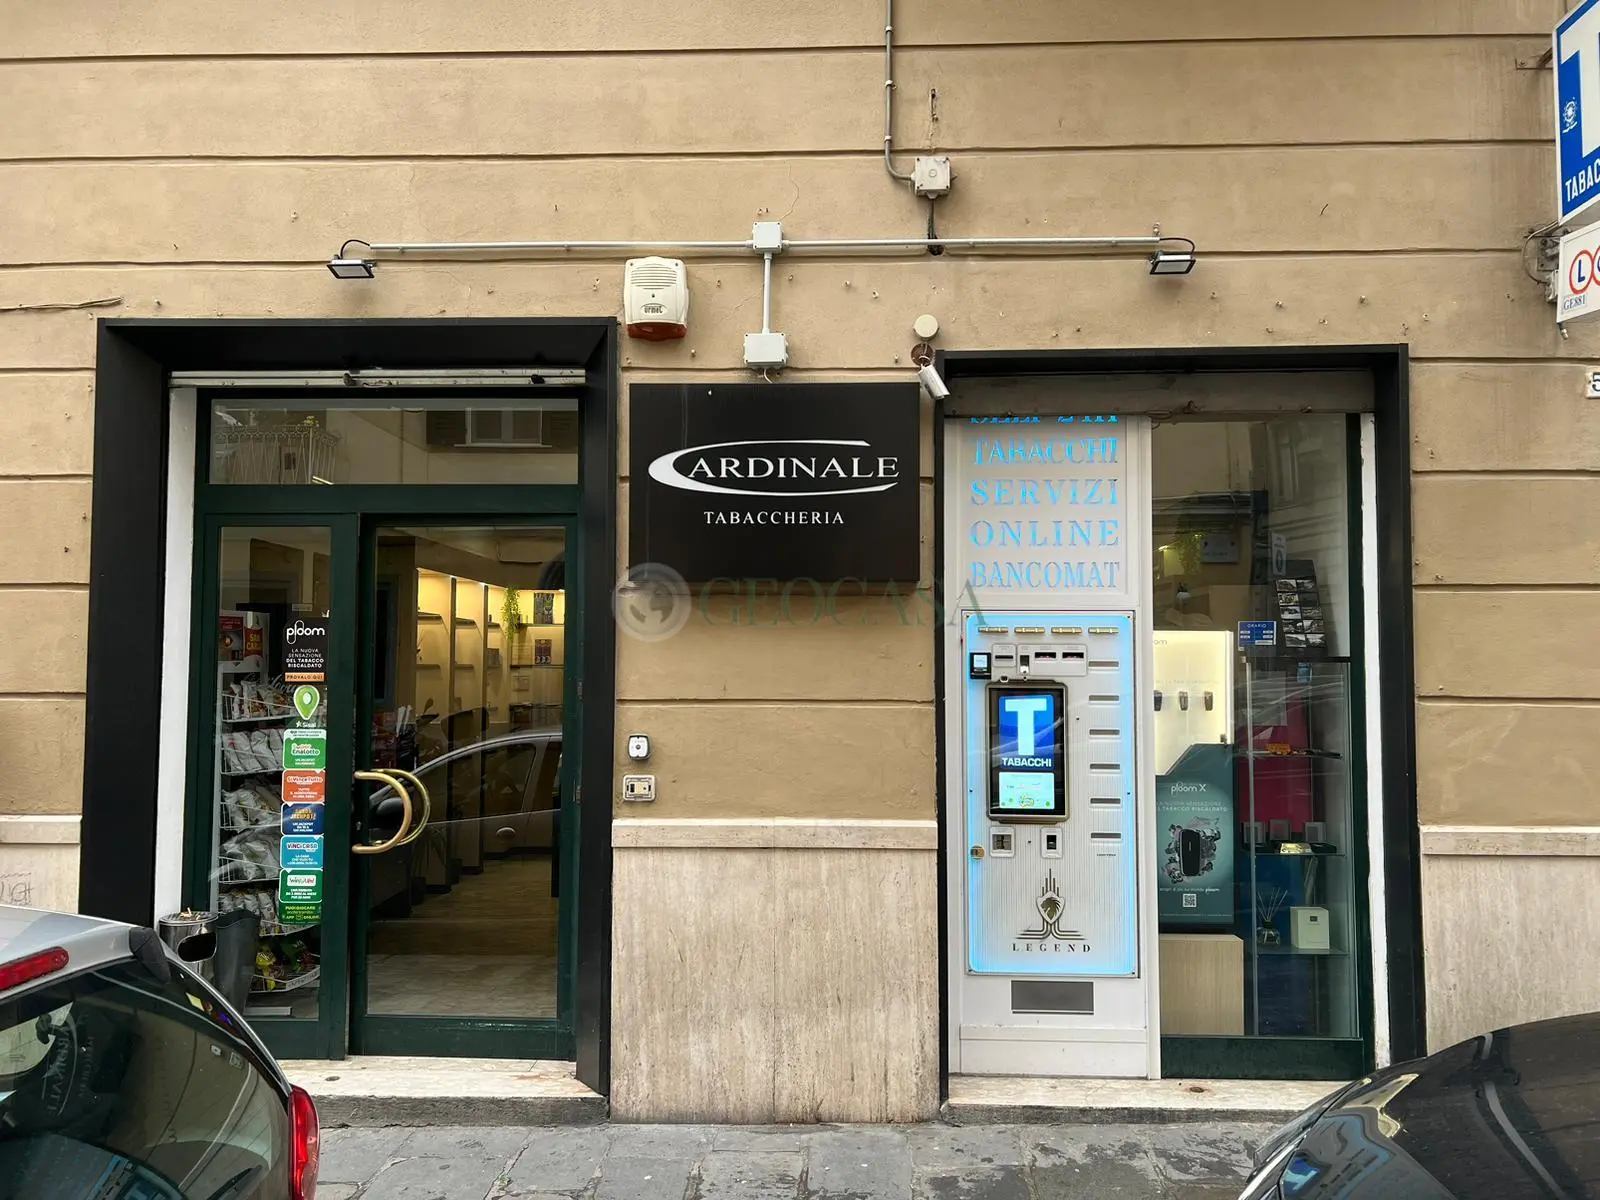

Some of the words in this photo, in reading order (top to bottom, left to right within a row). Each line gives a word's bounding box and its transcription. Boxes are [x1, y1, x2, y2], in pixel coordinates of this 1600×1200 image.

[973, 437, 1120, 465] TABACCHI
[648, 440, 900, 497] CARDINALE
[970, 478, 1119, 506] SERVIZI
[704, 511, 845, 525] TABACCHERIA
[970, 520, 1119, 547] ONLINE
[969, 561, 1120, 588] BANCOMAT
[286, 620, 326, 645] ploom
[1004, 698, 1047, 756] T
[1002, 757, 1052, 768] TABACCHI
[1171, 781, 1198, 797] ploom
[1199, 784, 1207, 792] X
[1012, 943, 1091, 953] LEGEND
